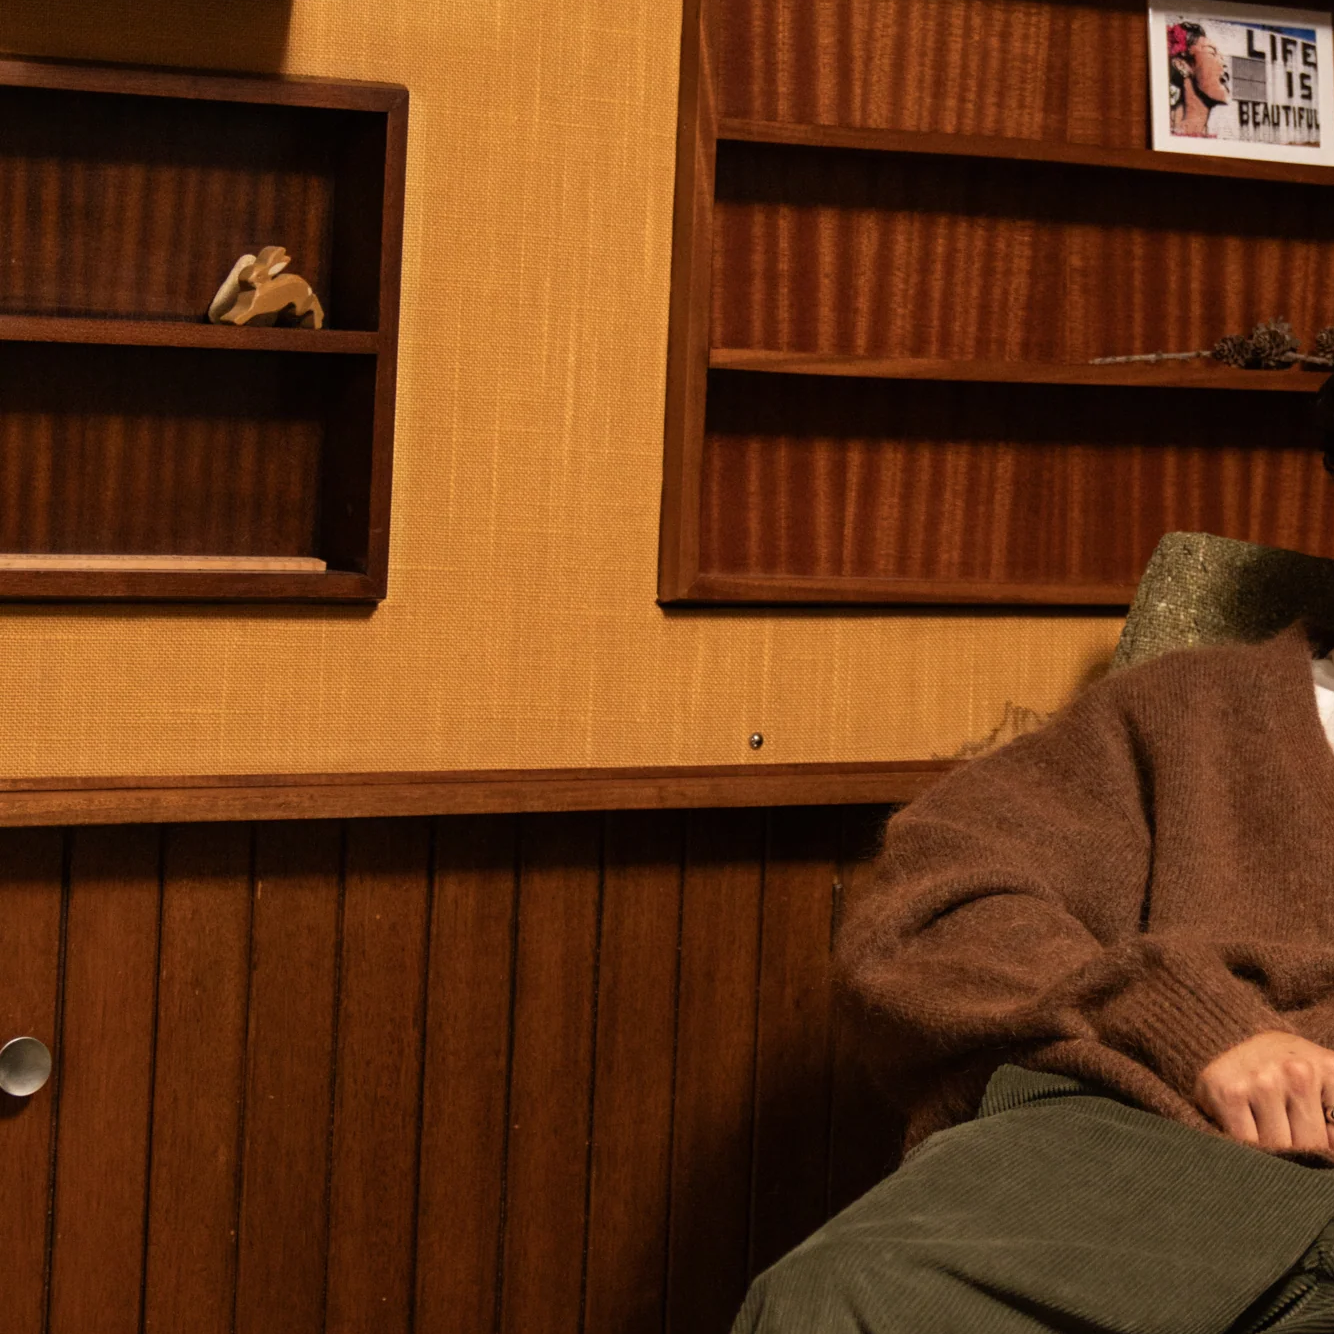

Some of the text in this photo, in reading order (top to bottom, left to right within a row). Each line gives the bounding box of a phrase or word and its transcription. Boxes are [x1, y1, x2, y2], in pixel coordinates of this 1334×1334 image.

[1246, 29, 1317, 68] LIFE
[1286, 71, 1312, 100] IS
[1238, 101, 1320, 130] BEAUTIFUL
